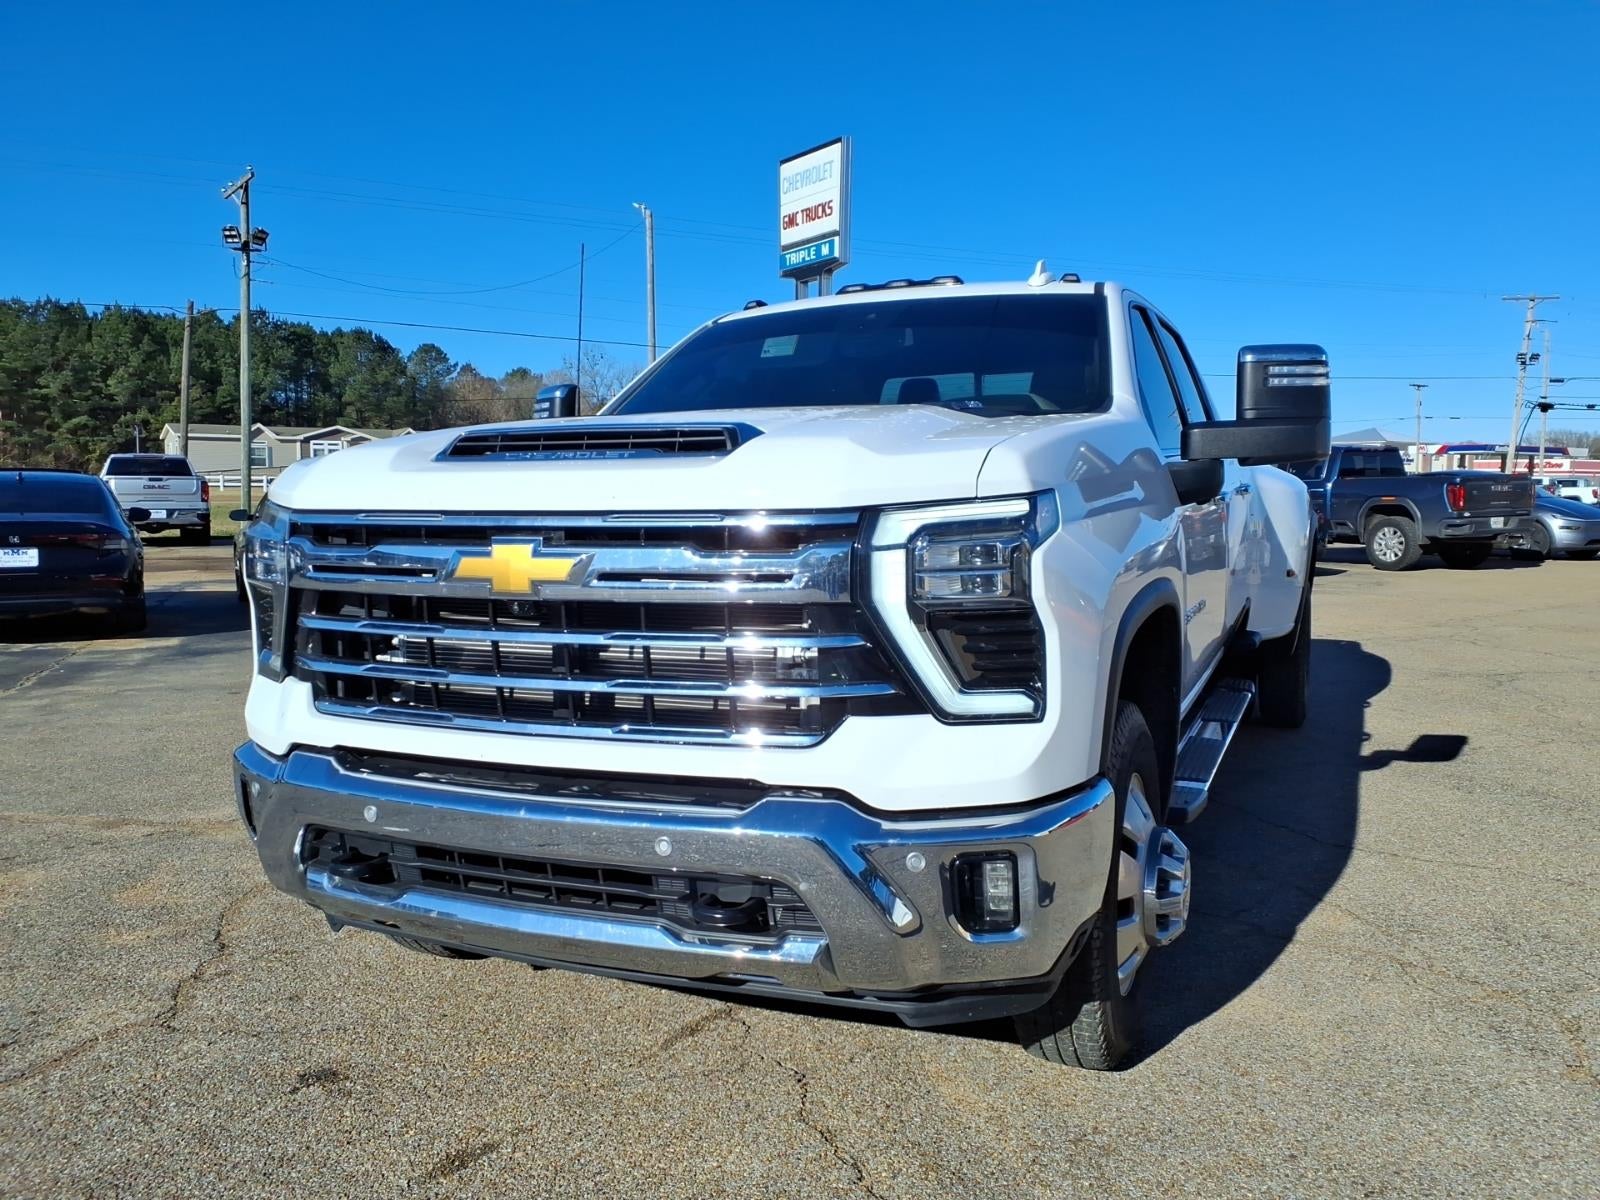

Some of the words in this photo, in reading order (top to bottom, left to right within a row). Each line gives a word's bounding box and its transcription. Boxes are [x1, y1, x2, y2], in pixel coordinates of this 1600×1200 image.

[782, 160, 834, 195] CHEVROLET
[782, 211, 800, 231] GMC
[801, 200, 833, 225] TRUCKS
[785, 247, 816, 266] TRIPLE
[821, 243, 830, 256] M
[504, 451, 636, 460] CHEVROLET
[1523, 461, 1564, 470] AtoZone
